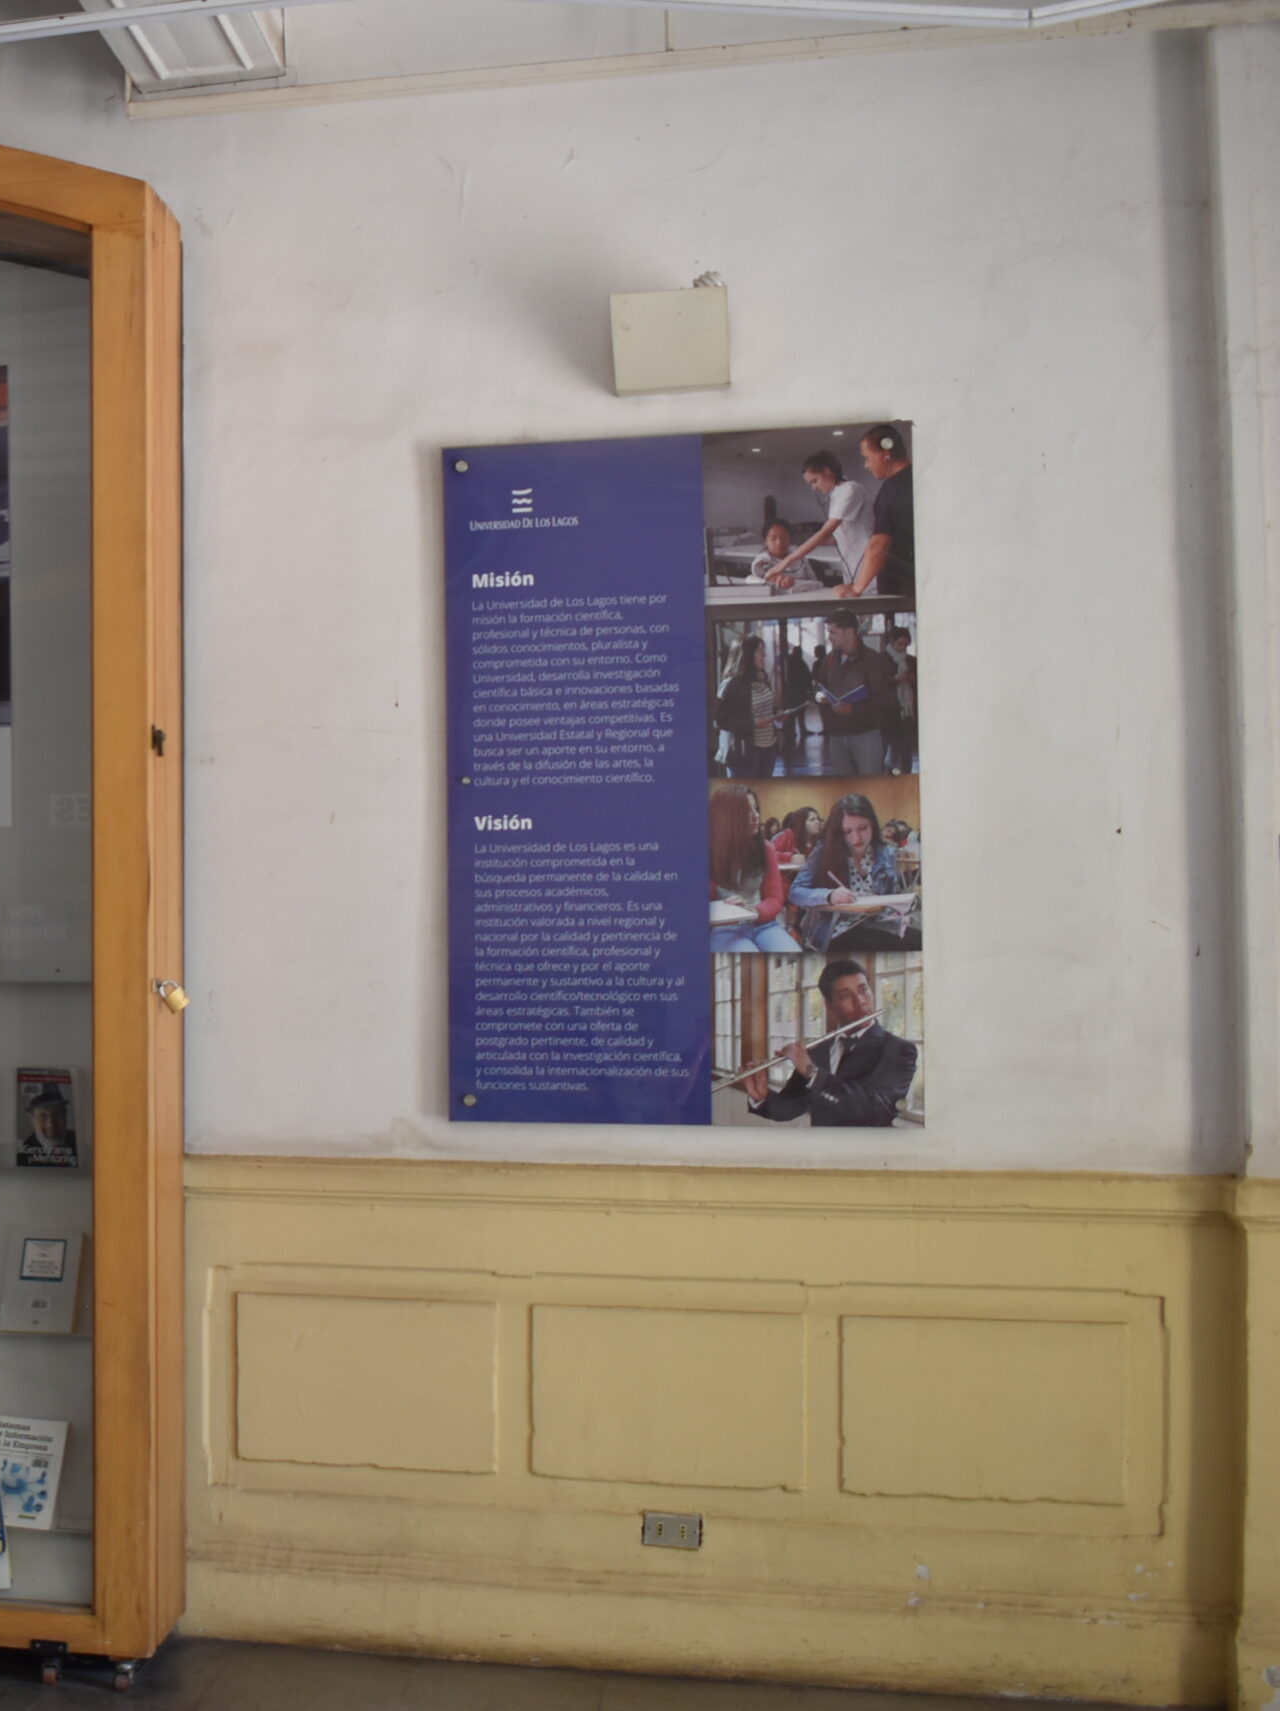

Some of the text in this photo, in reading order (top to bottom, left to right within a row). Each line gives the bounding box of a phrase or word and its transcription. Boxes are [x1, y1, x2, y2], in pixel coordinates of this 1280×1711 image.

[470, 519, 520, 531] UNIVERSIDAD
[535, 517, 550, 528] LOS
[552, 516, 579, 527] LAGOS
[472, 570, 534, 588] Misión
[471, 592, 666, 609] La Universidad de Los Lagos tiene por
[472, 612, 505, 624] misión
[508, 612, 517, 623] la
[520, 610, 572, 623] formación
[472, 626, 529, 642] profesional
[540, 624, 576, 637] técnica
[579, 624, 592, 636] de
[649, 624, 669, 633] con
[472, 642, 507, 654] sólidos
[591, 638, 639, 653] pluralista
[472, 655, 548, 672] comprometida
[550, 657, 569, 666] con
[572, 657, 584, 665] su
[635, 651, 667, 663] Como
[538, 668, 590, 681] desarrolla
[593, 666, 660, 682] investigación
[474, 814, 532, 830] Visión
[474, 840, 659, 854] La Universidad de Los Lagos es una
[474, 854, 635, 869] institución comprometida en la
[474, 888, 492, 897] sus
[494, 888, 541, 900] procesos
[474, 900, 552, 911] administrativos
[626, 900, 639, 911] Es
[641, 902, 662, 911] una
[475, 990, 678, 1004] desarrollo científico/tecnológico en sus
[475, 1078, 526, 1090] funciones
[5, 1430, 53, 1442] Información
[13, 1440, 48, 1451] Empresa
